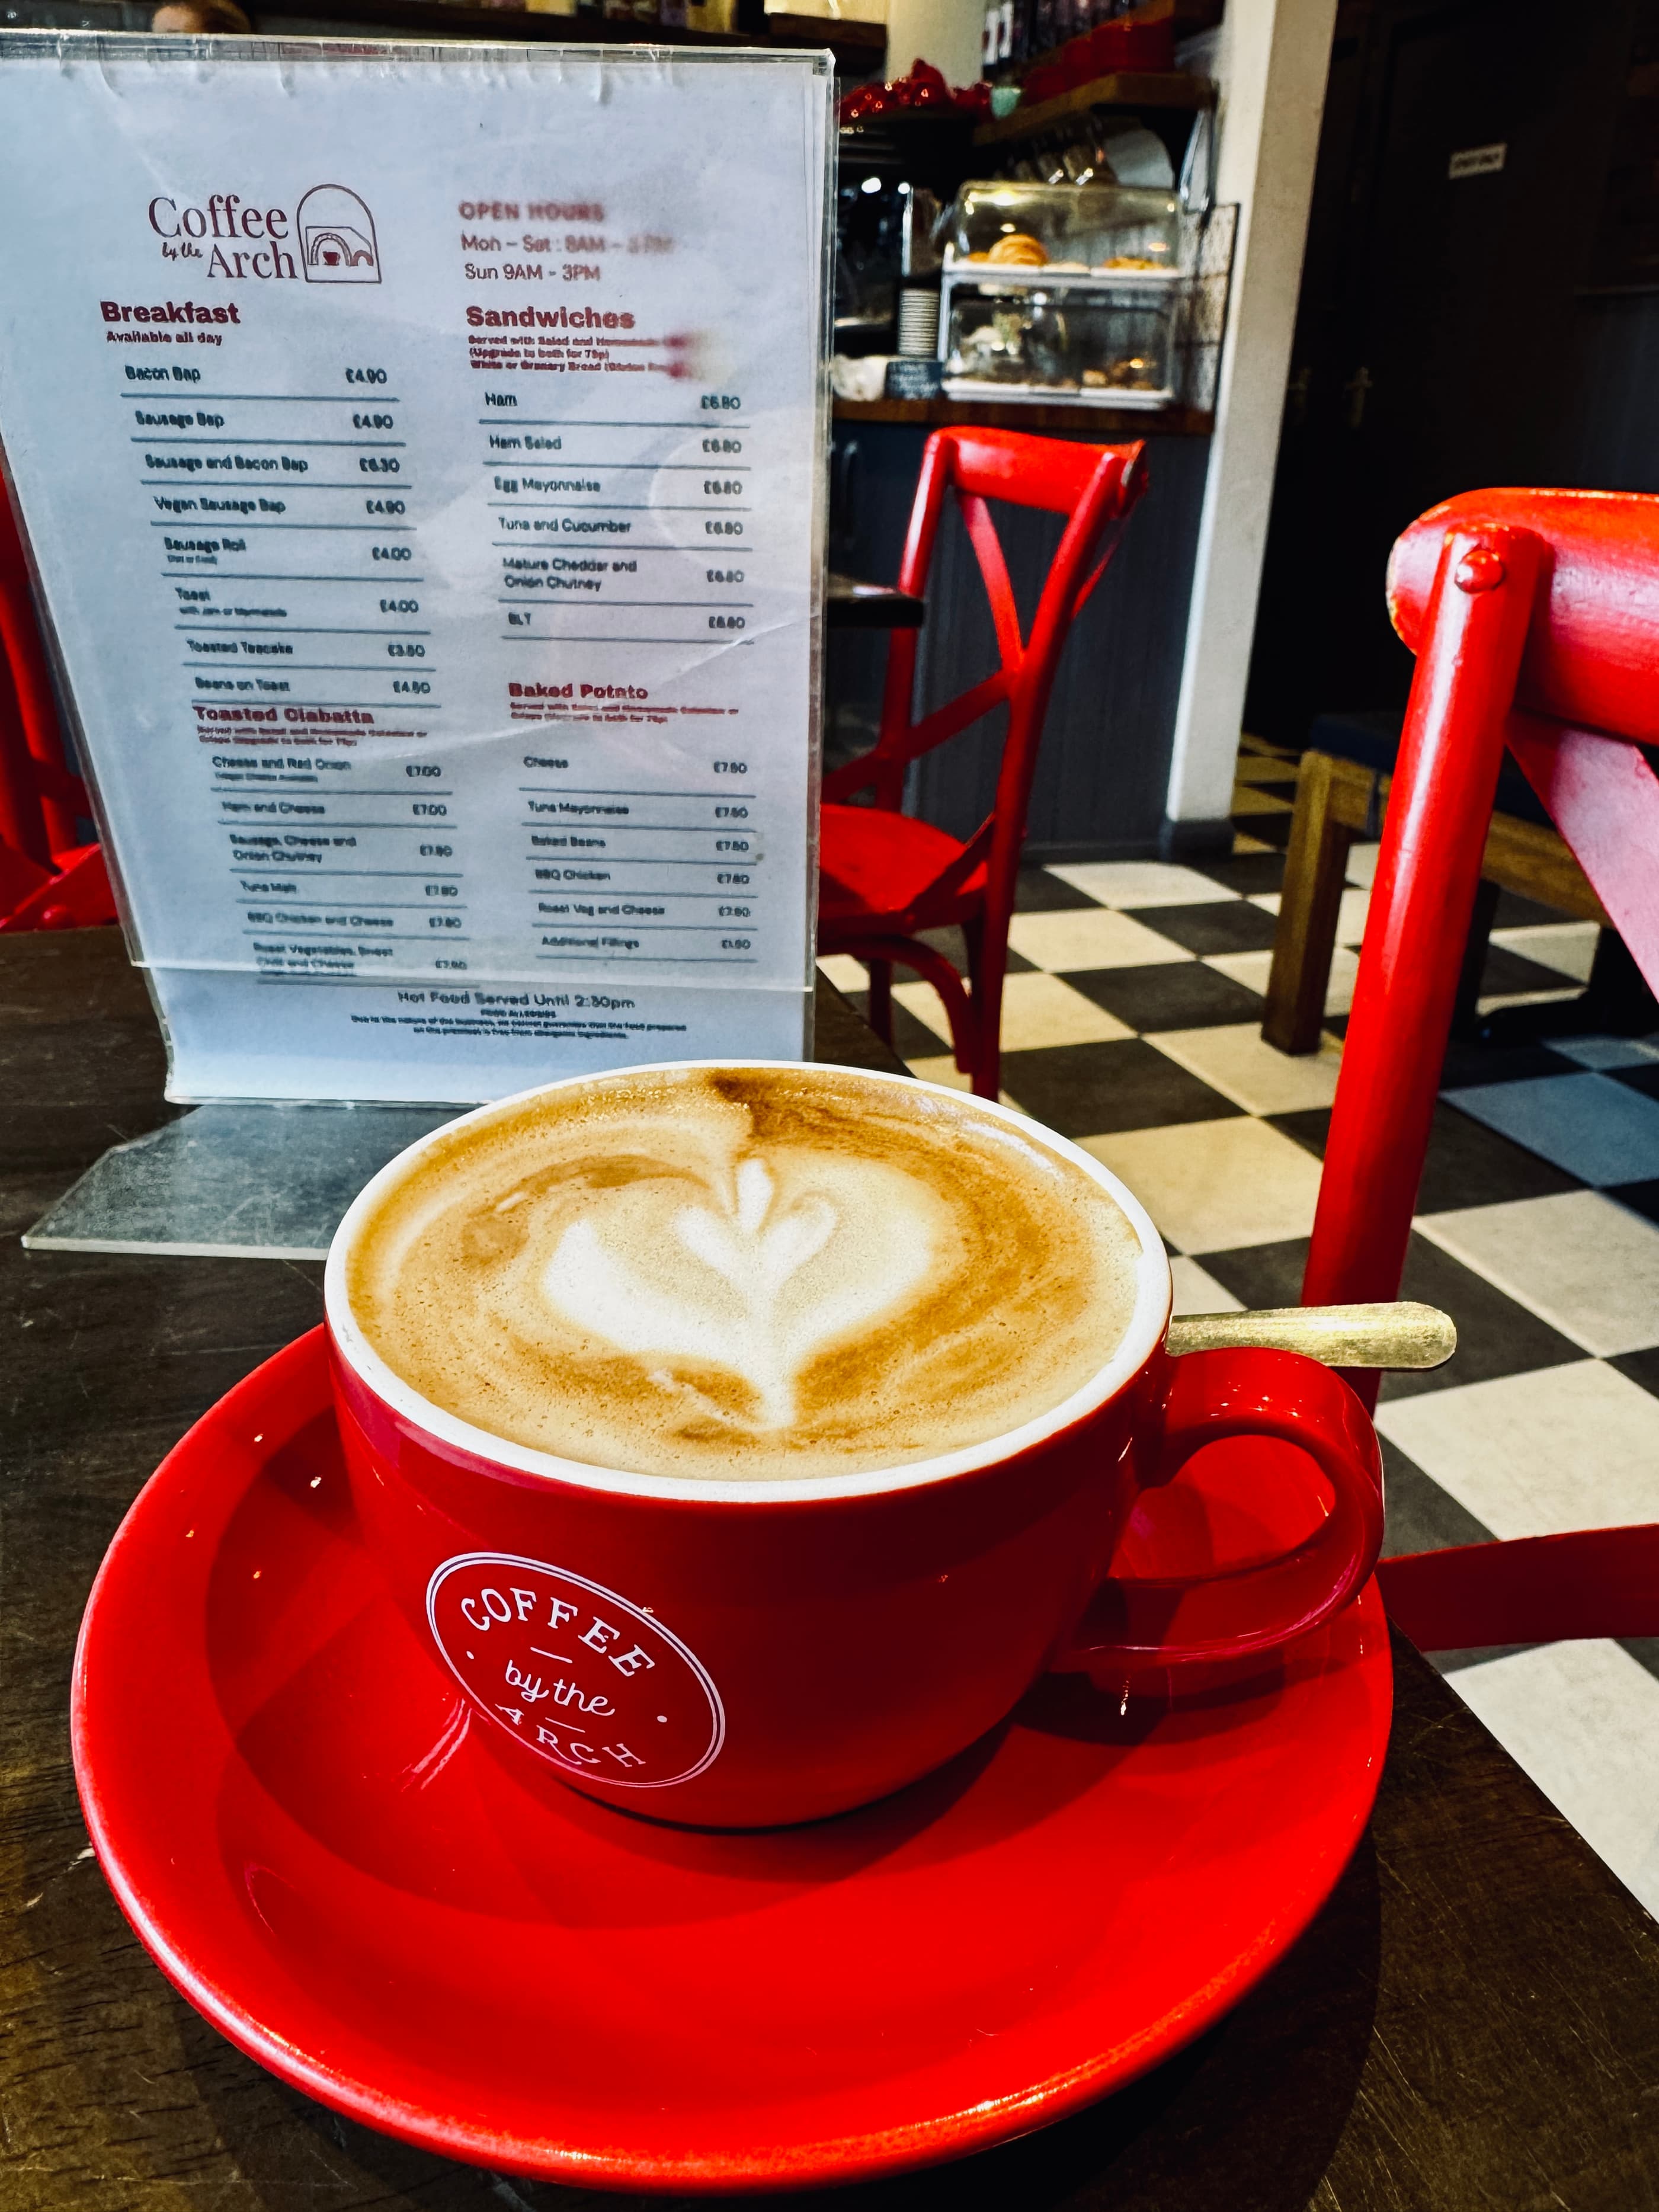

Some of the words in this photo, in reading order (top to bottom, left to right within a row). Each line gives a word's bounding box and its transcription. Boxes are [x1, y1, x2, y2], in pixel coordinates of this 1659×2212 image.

[149, 194, 289, 239] Coffee
[459, 201, 520, 220] OPEN
[162, 242, 178, 261] by
[181, 241, 203, 258] the
[462, 233, 501, 251] Mon
[207, 241, 298, 279] Arch
[465, 264, 498, 280] Sun
[504, 264, 542, 280] 9AM
[562, 264, 600, 281] 3PM
[101, 301, 241, 324] Breakfast
[466, 306, 636, 329] Sandwiches
[107, 331, 172, 344] Available
[176, 332, 193, 342] all
[198, 333, 222, 346] day
[125, 365, 169, 380] Bacon
[173, 366, 201, 383] Bap
[485, 392, 518, 406] Ham
[136, 411, 193, 428] Sausage
[197, 412, 225, 428] Bap
[489, 435, 521, 449] Ham
[525, 436, 562, 450] Salad
[146, 454, 202, 472] Sausage
[207, 456, 232, 469] and
[235, 455, 277, 470] Bacon
[282, 456, 308, 472] Bap
[494, 476, 518, 492] Egg
[523, 477, 601, 493] Mayonnaise
[153, 497, 197, 513] Vegan
[200, 498, 256, 514] Sausage
[259, 498, 286, 514] Bap
[499, 517, 530, 530] Tuna
[534, 518, 558, 532] and
[562, 518, 631, 533] Cucumber
[372, 548, 411, 559] £4.00
[502, 558, 549, 570] Mature
[552, 558, 608, 571] Cheddar
[612, 559, 637, 572] and
[505, 576, 543, 588] Onion
[547, 577, 602, 591] Chutney
[508, 682, 573, 698] Baked
[580, 683, 649, 699] Potato
[193, 706, 277, 722] Toasted
[284, 707, 374, 724] Ciabatta
[398, 991, 424, 1003] Hot
[430, 991, 470, 1004] Food
[475, 992, 529, 1006] Served
[534, 994, 569, 1006] Until
[574, 995, 636, 1010] 2:30pm
[460, 1587, 655, 1677] COFFEE
[505, 1660, 549, 1701] by
[553, 1679, 616, 1715] the
[494, 1703, 646, 1768] ARCH
